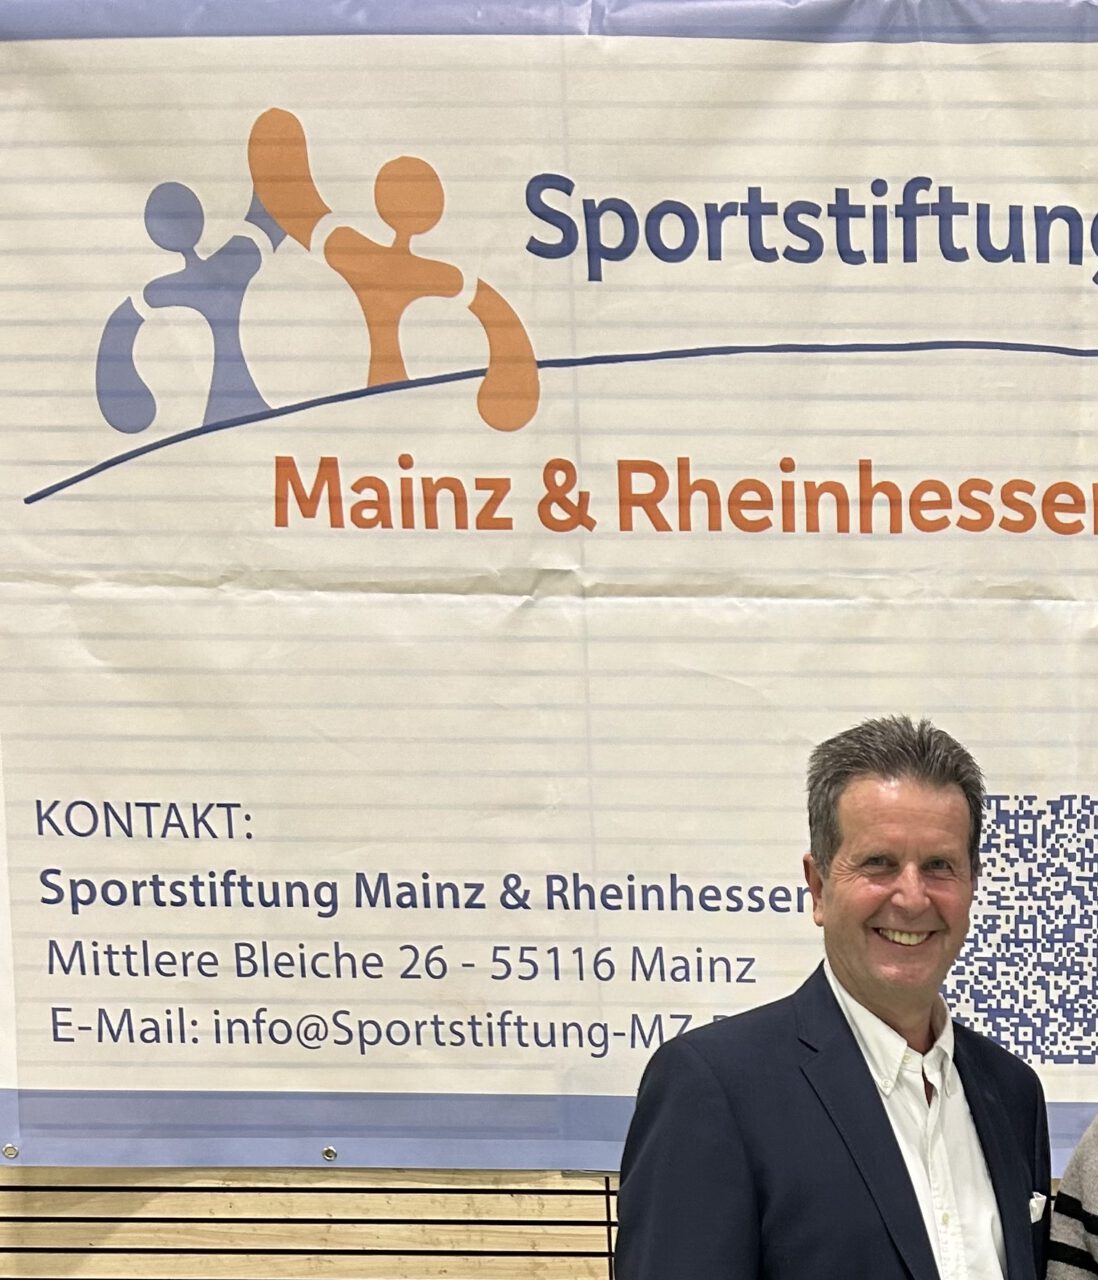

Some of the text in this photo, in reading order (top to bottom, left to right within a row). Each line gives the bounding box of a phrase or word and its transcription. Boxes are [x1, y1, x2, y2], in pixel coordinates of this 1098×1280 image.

[273, 453, 513, 532] Mainz
[537, 457, 598, 533] &
[35, 799, 253, 840] KONTAKT:
[39, 868, 338, 919] Sportstiftung
[355, 871, 486, 910] Mainz
[499, 873, 532, 911] &
[48, 939, 219, 978] Mittlere
[234, 940, 384, 980] Bleiche
[399, 944, 448, 981] 26
[491, 945, 615, 983] 55116
[631, 946, 756, 983] Mainz
[51, 1007, 199, 1044] E-Mail:
